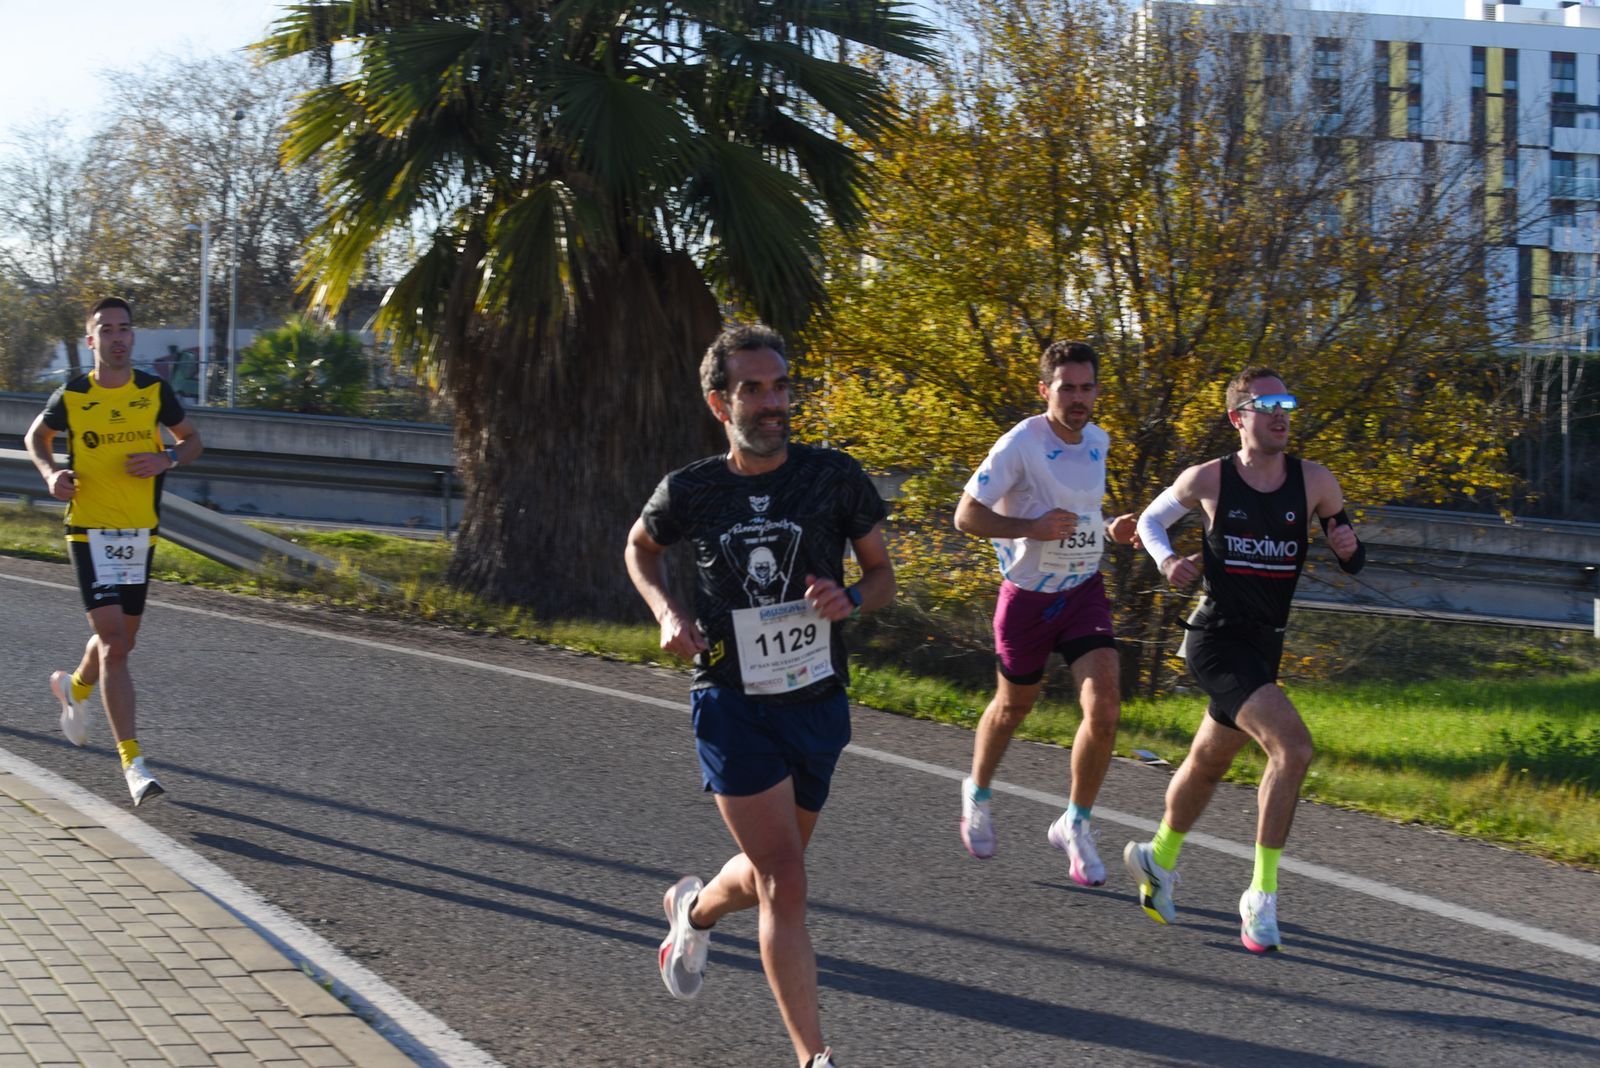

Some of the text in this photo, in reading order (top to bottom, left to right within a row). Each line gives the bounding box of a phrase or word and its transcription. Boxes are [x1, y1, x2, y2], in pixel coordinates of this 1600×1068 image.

[82, 430, 152, 449] AIRZONE
[105, 545, 135, 560] 843
[755, 623, 817, 657] 1129
